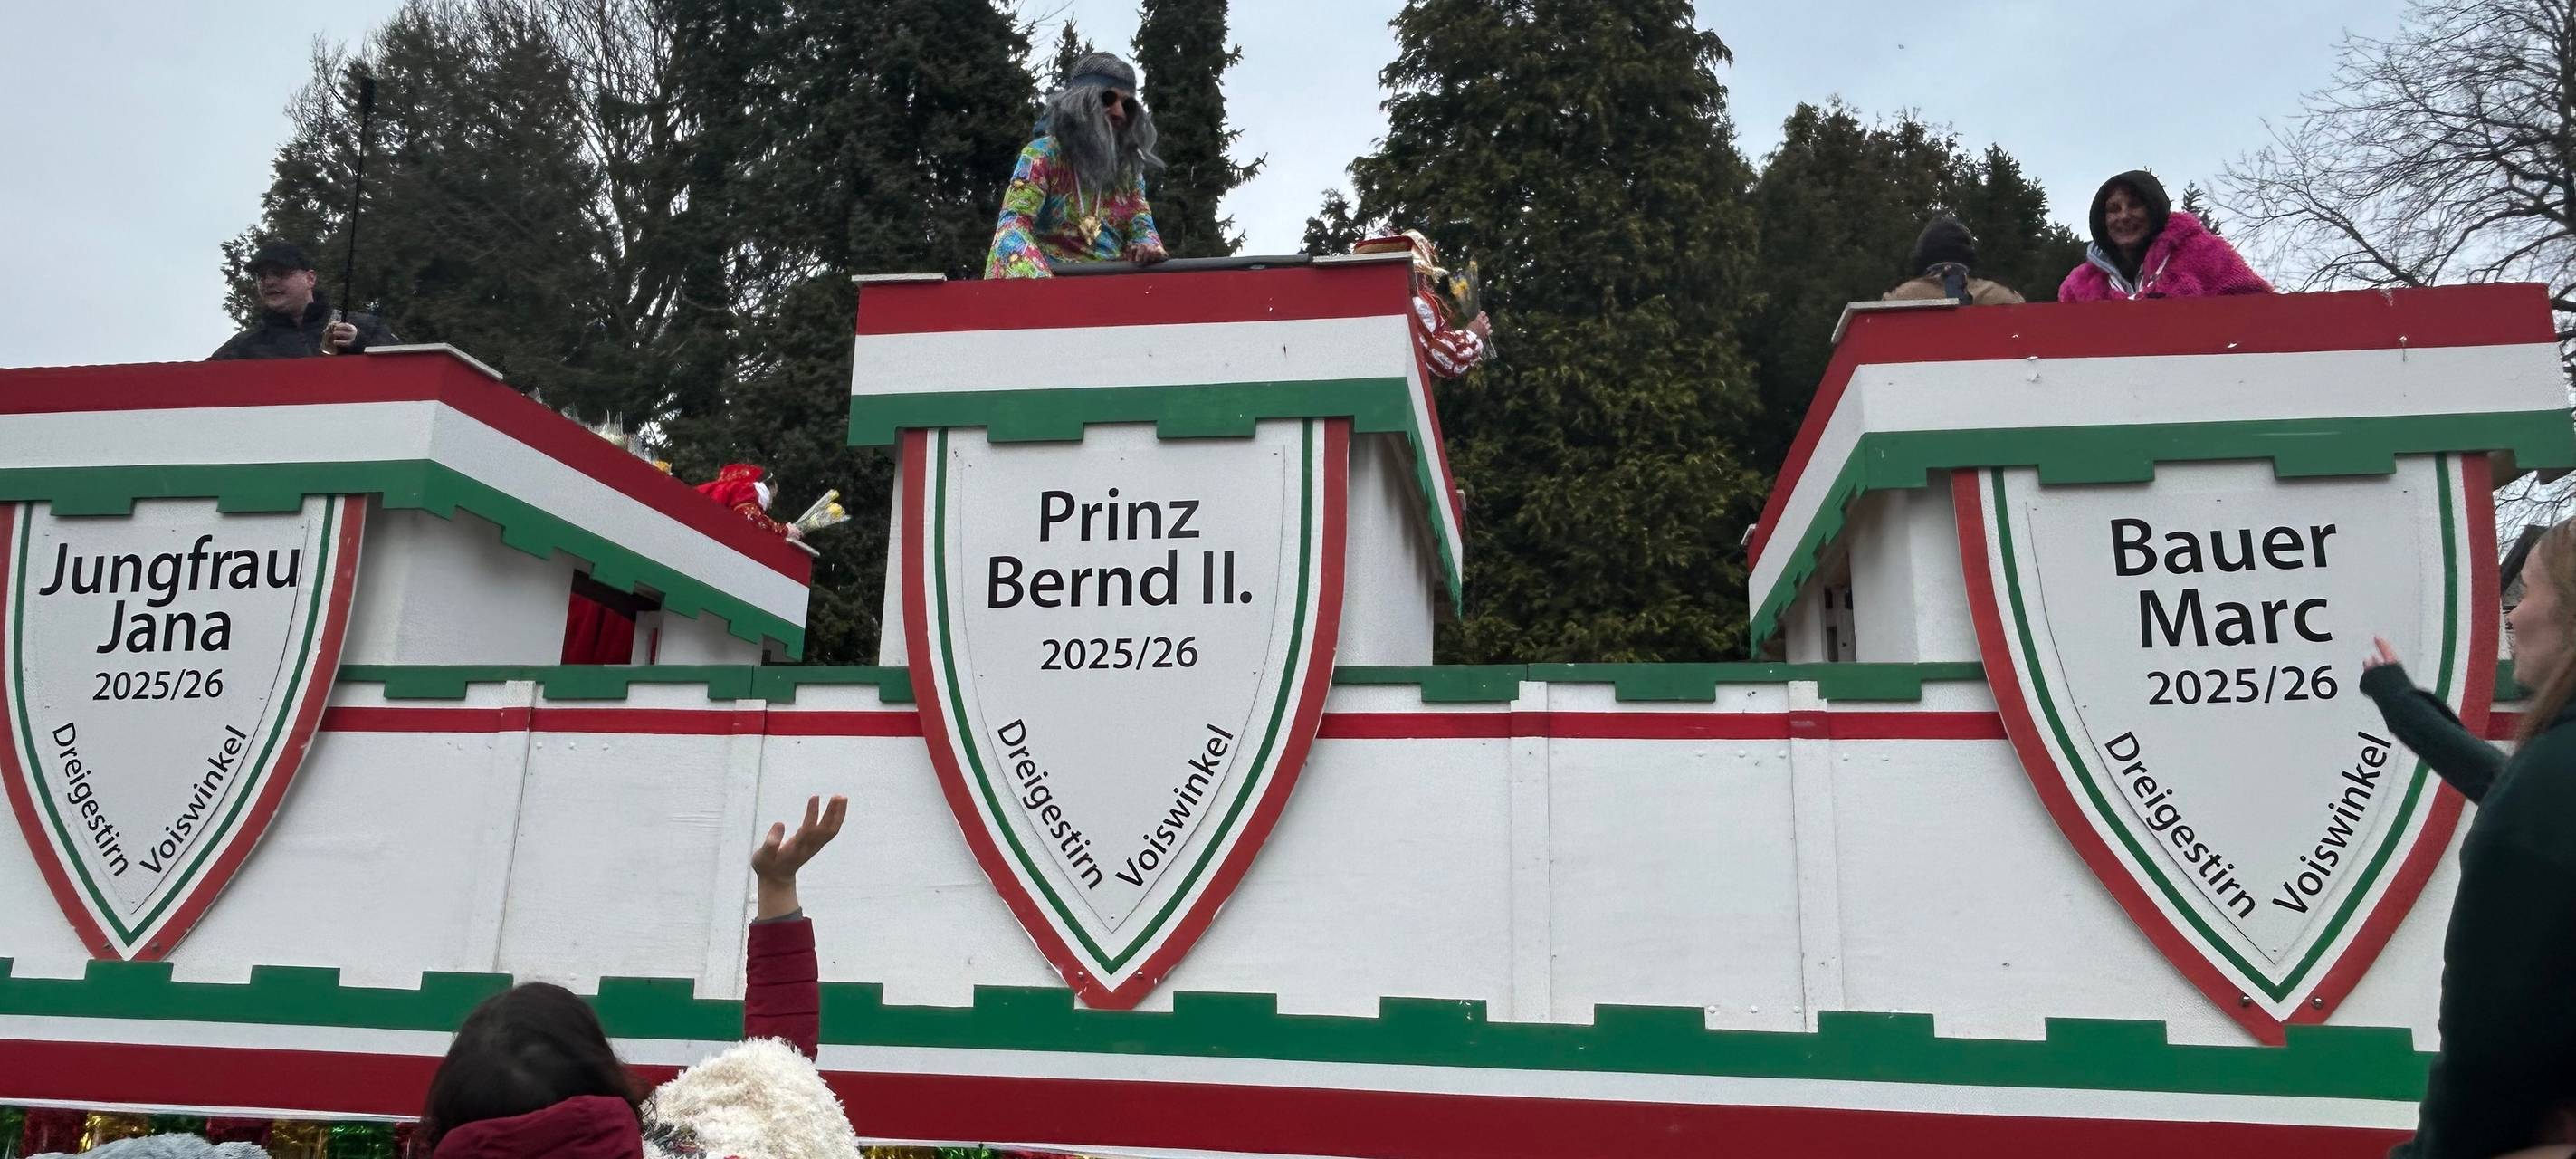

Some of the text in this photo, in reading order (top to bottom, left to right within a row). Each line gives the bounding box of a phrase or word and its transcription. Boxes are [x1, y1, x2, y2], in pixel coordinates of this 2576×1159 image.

[1039, 487, 1200, 542] Prinz
[38, 534, 301, 607] Jungfrau
[2110, 516, 2338, 577] Bauer
[987, 550, 1253, 608] Bernd II.
[97, 599, 231, 654] Jana
[2138, 589, 2333, 648] Marc
[1040, 636, 1198, 670] 2025/26
[92, 668, 224, 701] 2025/26
[2146, 665, 2339, 705] 2025/26
[52, 722, 131, 877] Dreigestirn
[139, 724, 247, 876] Voiswinkel
[997, 718, 1105, 891] Dreigestirn
[1115, 723, 1233, 888] Voiswinkel
[2104, 731, 2256, 920] Dreigestirn
[2272, 731, 2392, 915] Voiswinkel
